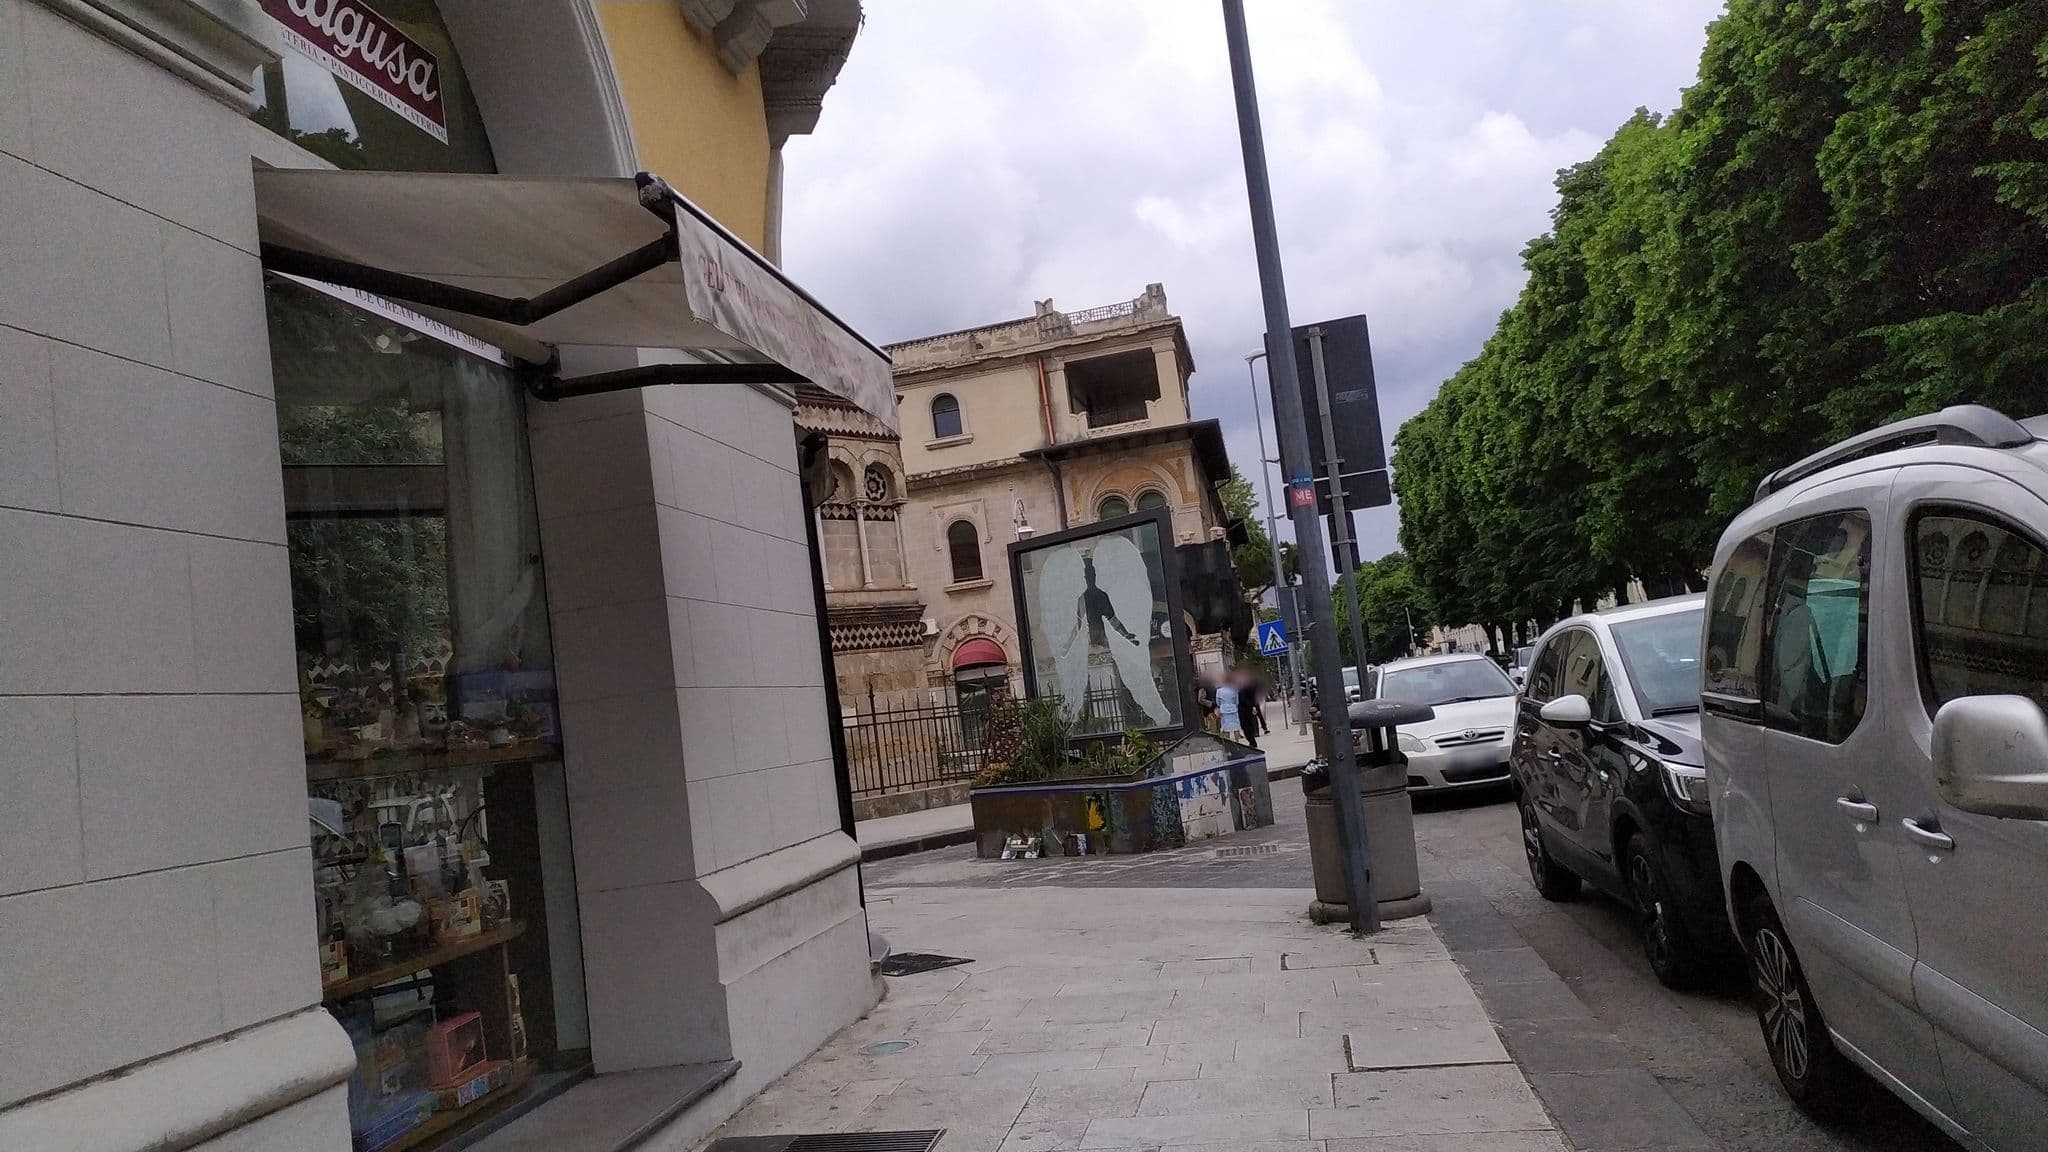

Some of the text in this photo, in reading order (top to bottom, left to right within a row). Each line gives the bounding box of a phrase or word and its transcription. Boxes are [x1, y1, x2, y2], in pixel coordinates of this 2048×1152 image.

[331, 60, 394, 109] PASTICCERIA
[403, 103, 447, 141] CATERING
[354, 287, 486, 350] ICE CREAM PASTRY SHOP
